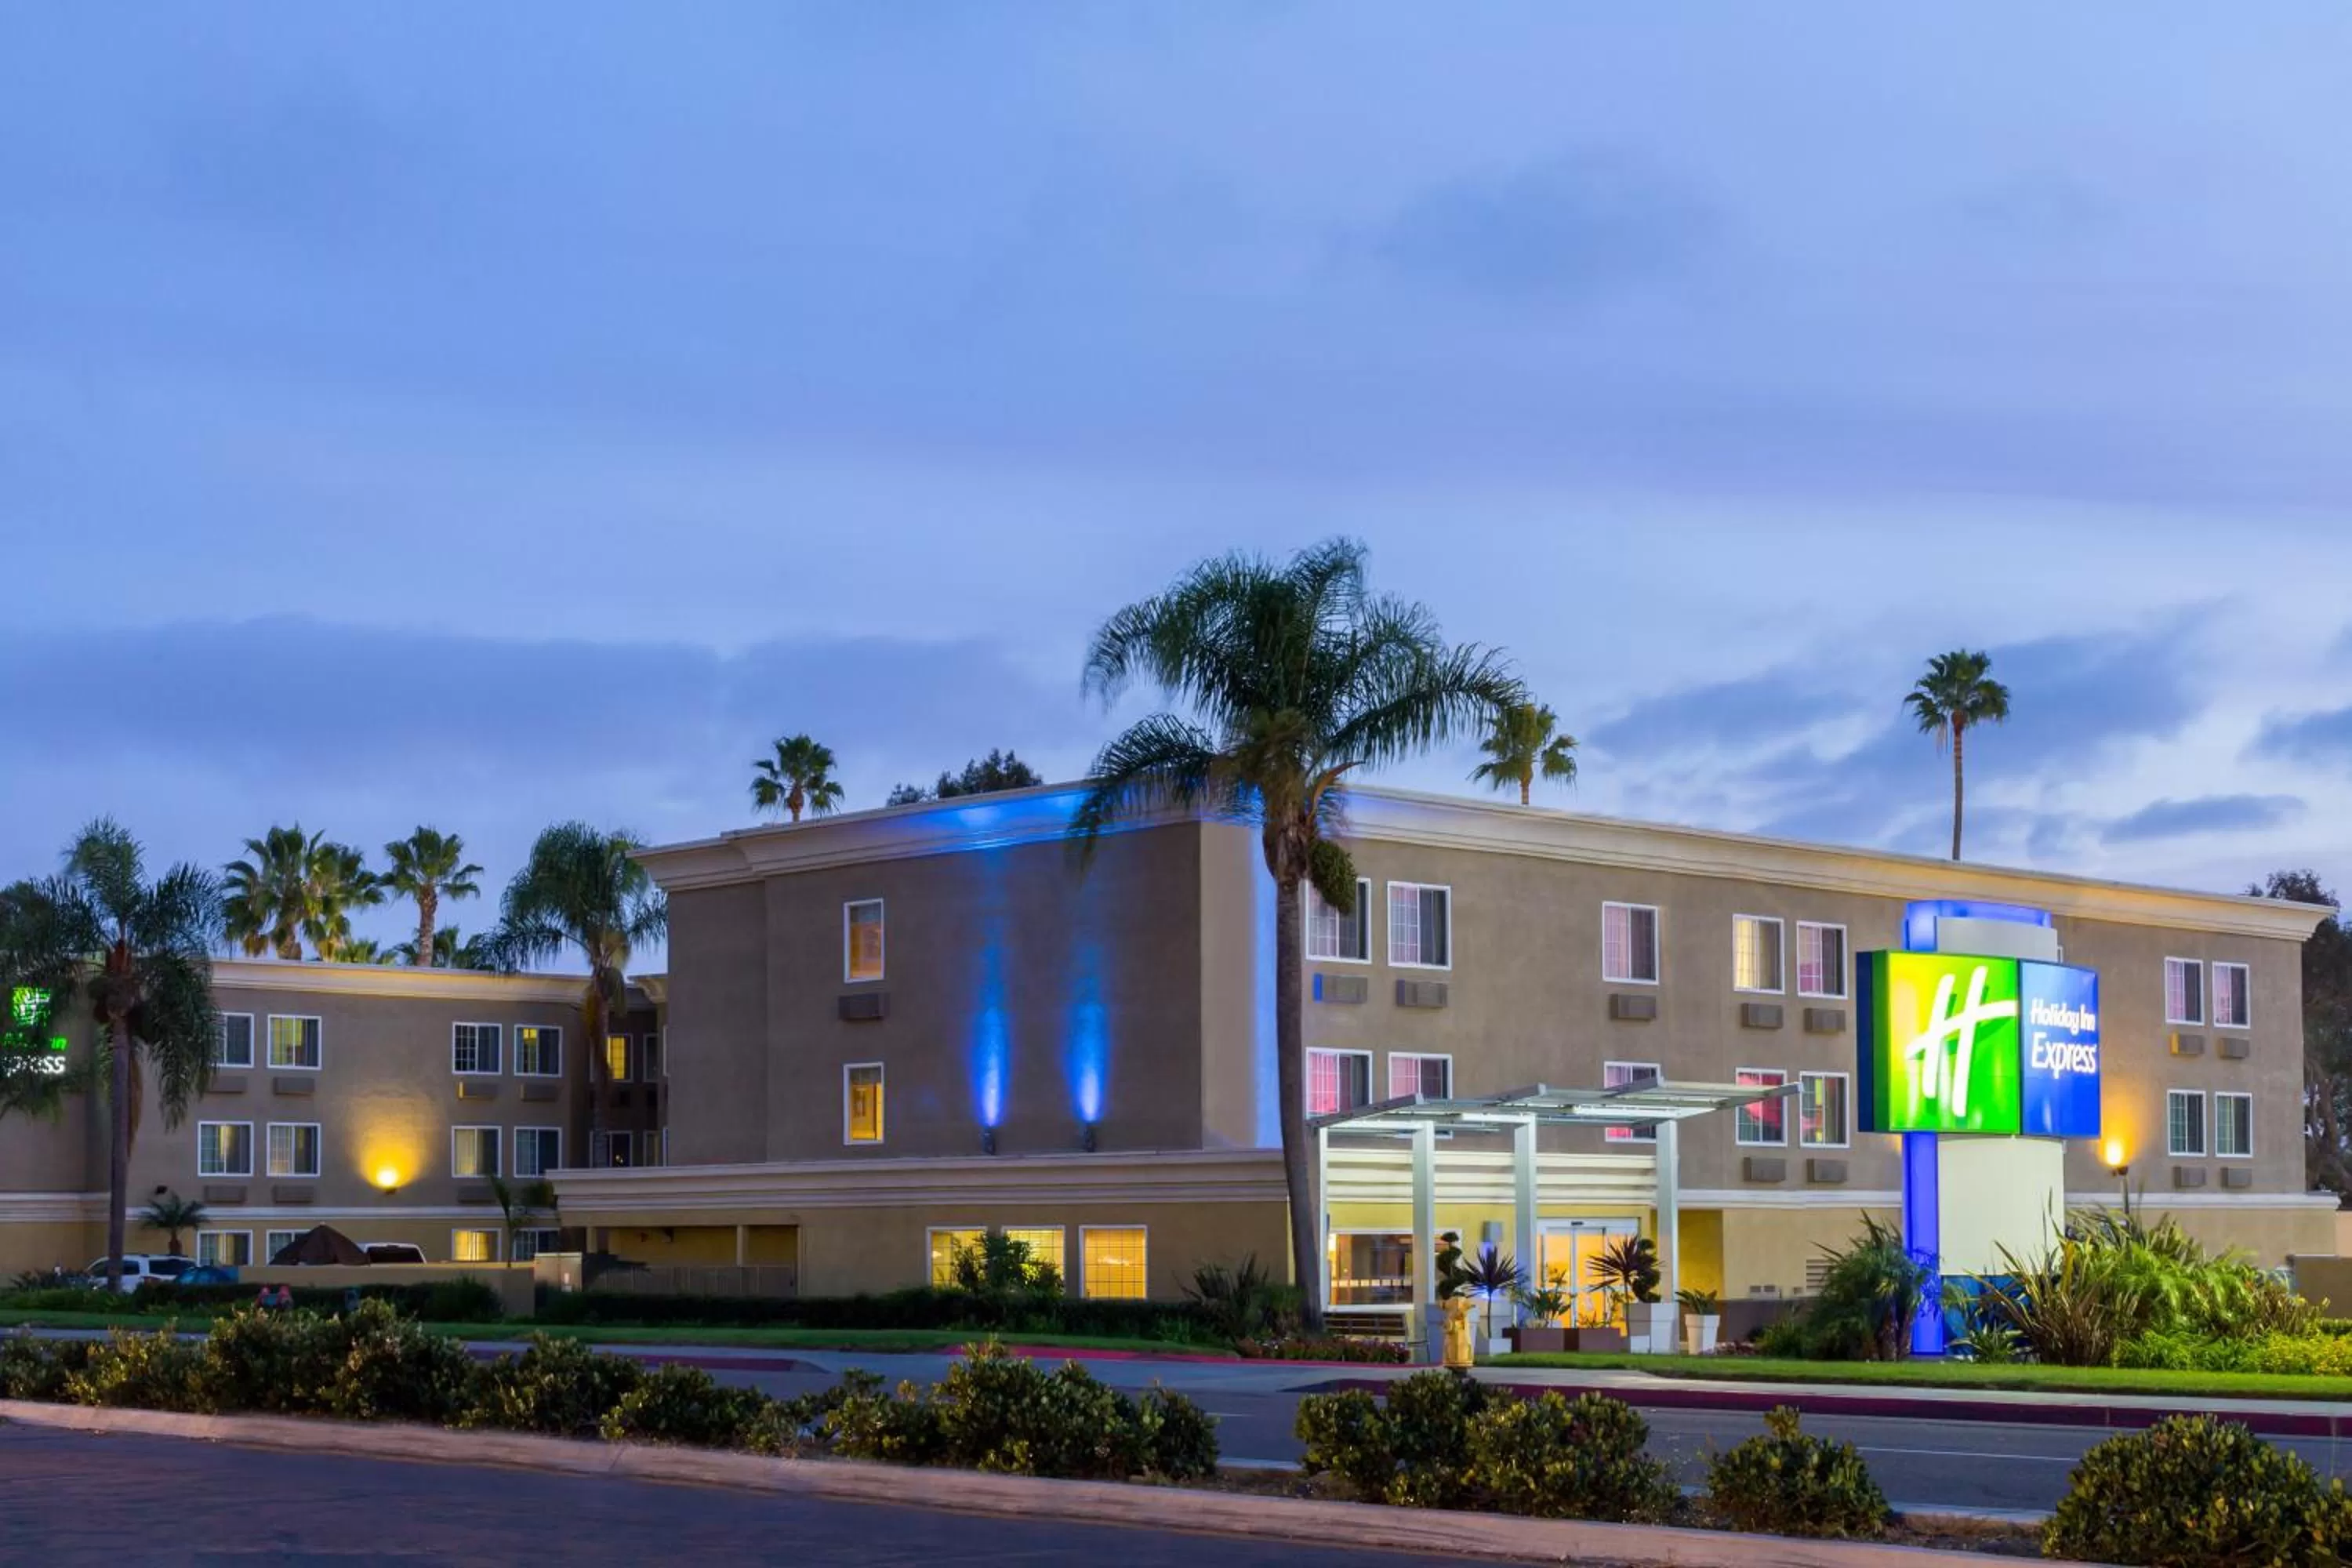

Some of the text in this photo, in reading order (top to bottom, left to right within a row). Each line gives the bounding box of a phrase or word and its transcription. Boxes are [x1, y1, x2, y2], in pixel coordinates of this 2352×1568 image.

[2031, 997, 2096, 1036] Holiday Inn
[2031, 1031, 2096, 1079] Express
